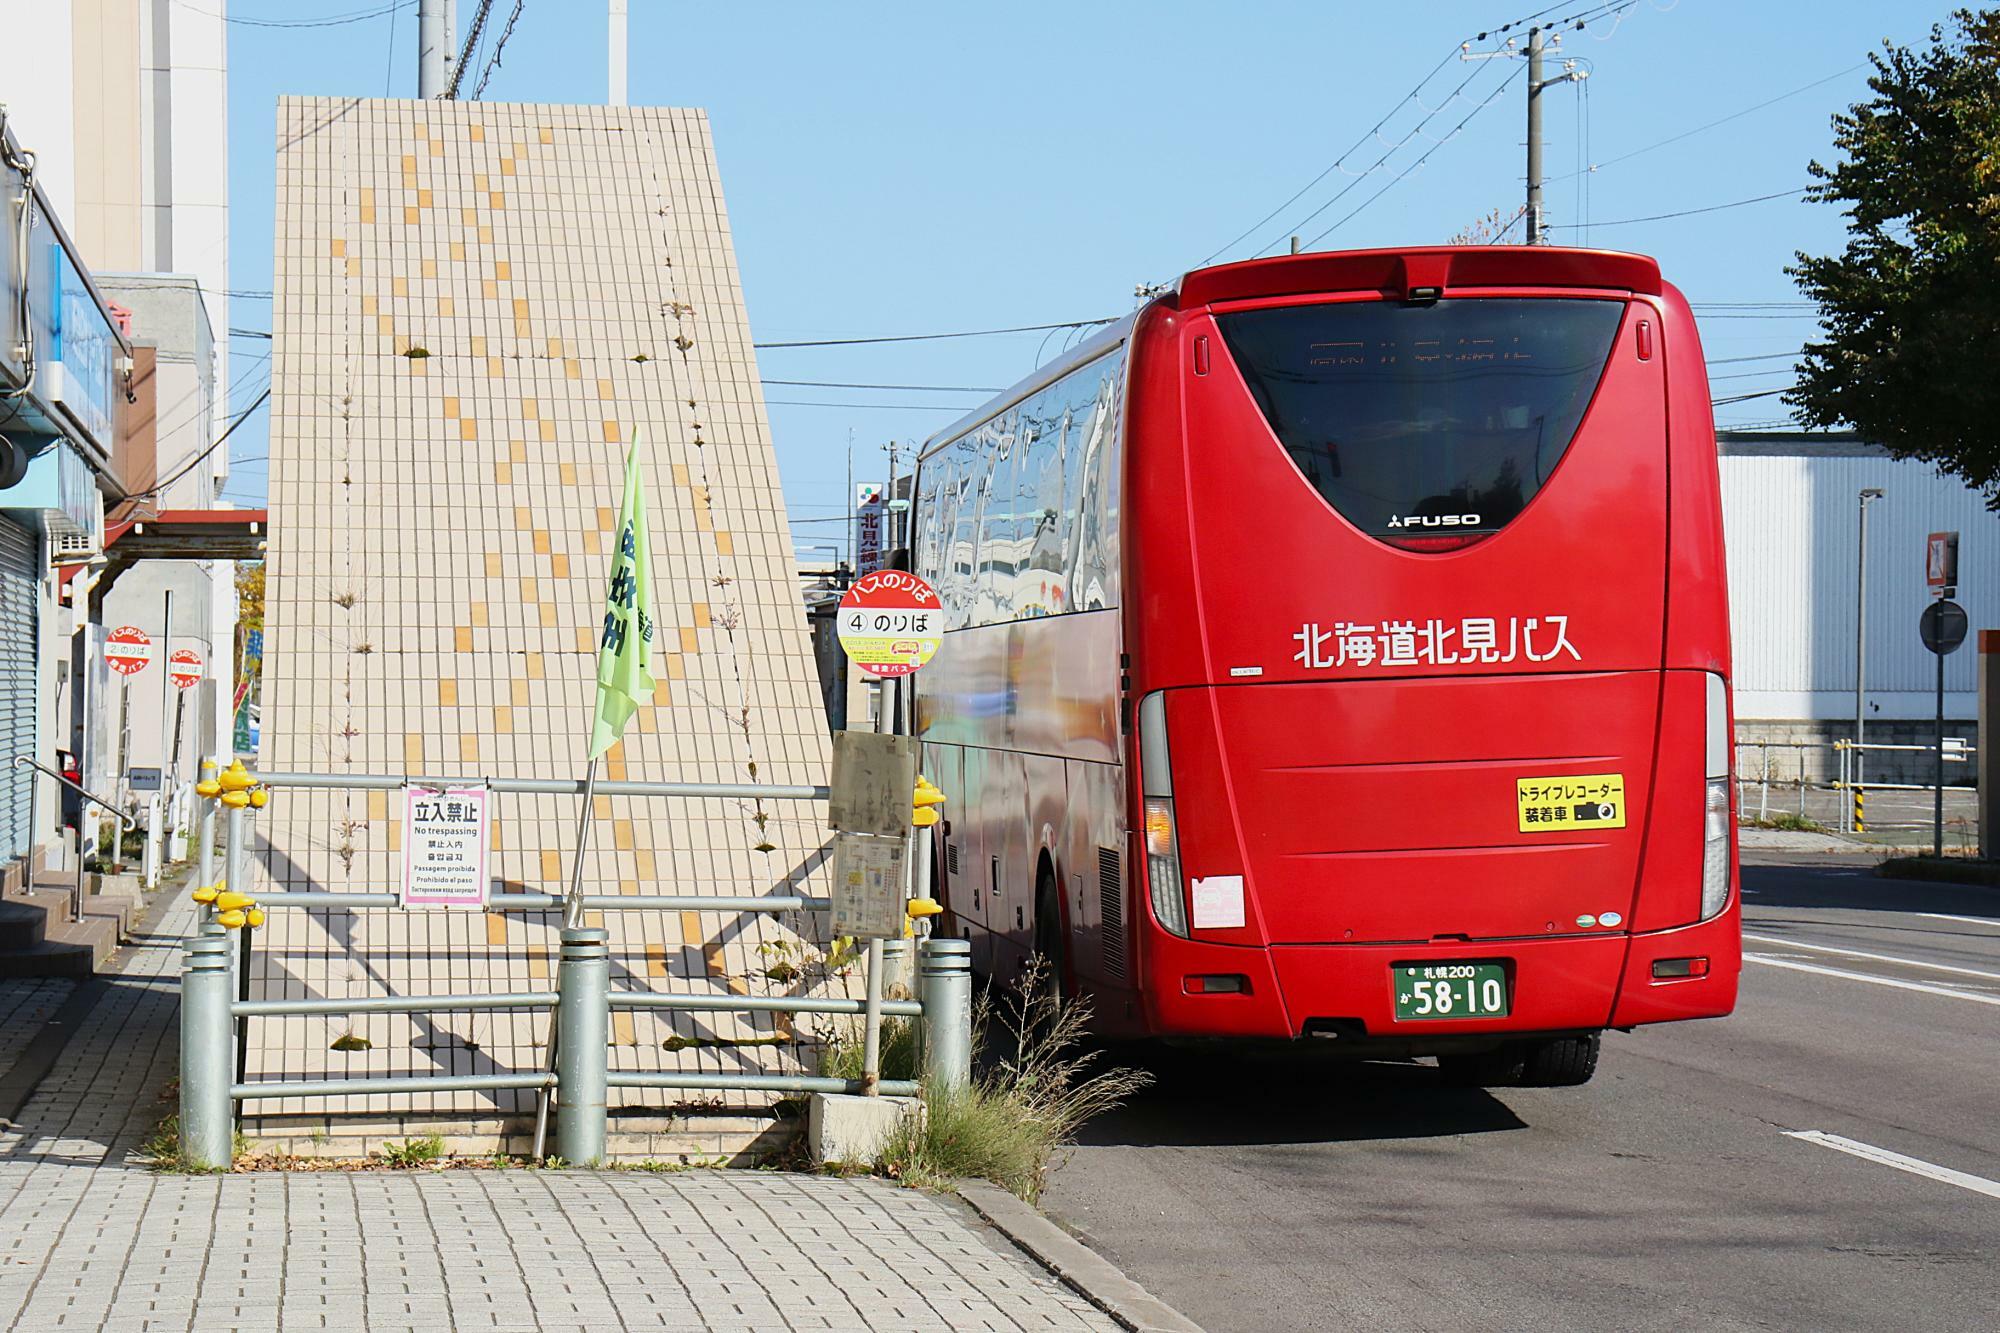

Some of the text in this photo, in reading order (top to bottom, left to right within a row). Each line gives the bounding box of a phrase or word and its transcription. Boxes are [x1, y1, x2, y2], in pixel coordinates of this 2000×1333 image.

[1403, 514, 1481, 527] FUSO
[851, 573, 934, 604] バスのりば
[1293, 615, 1583, 668] 北海道北見バス
[1519, 783, 1622, 802] ドライブレコーダー
[414, 802, 478, 823] 立入禁止
[1525, 806, 1568, 823] 装着車
[414, 827, 478, 837] No trespassing
[428, 840, 463, 849] 禁止入内
[414, 865, 476, 873] Passagem proibida
[1423, 965, 1476, 979] 札幌200
[1400, 979, 1501, 1014] か 58-10
